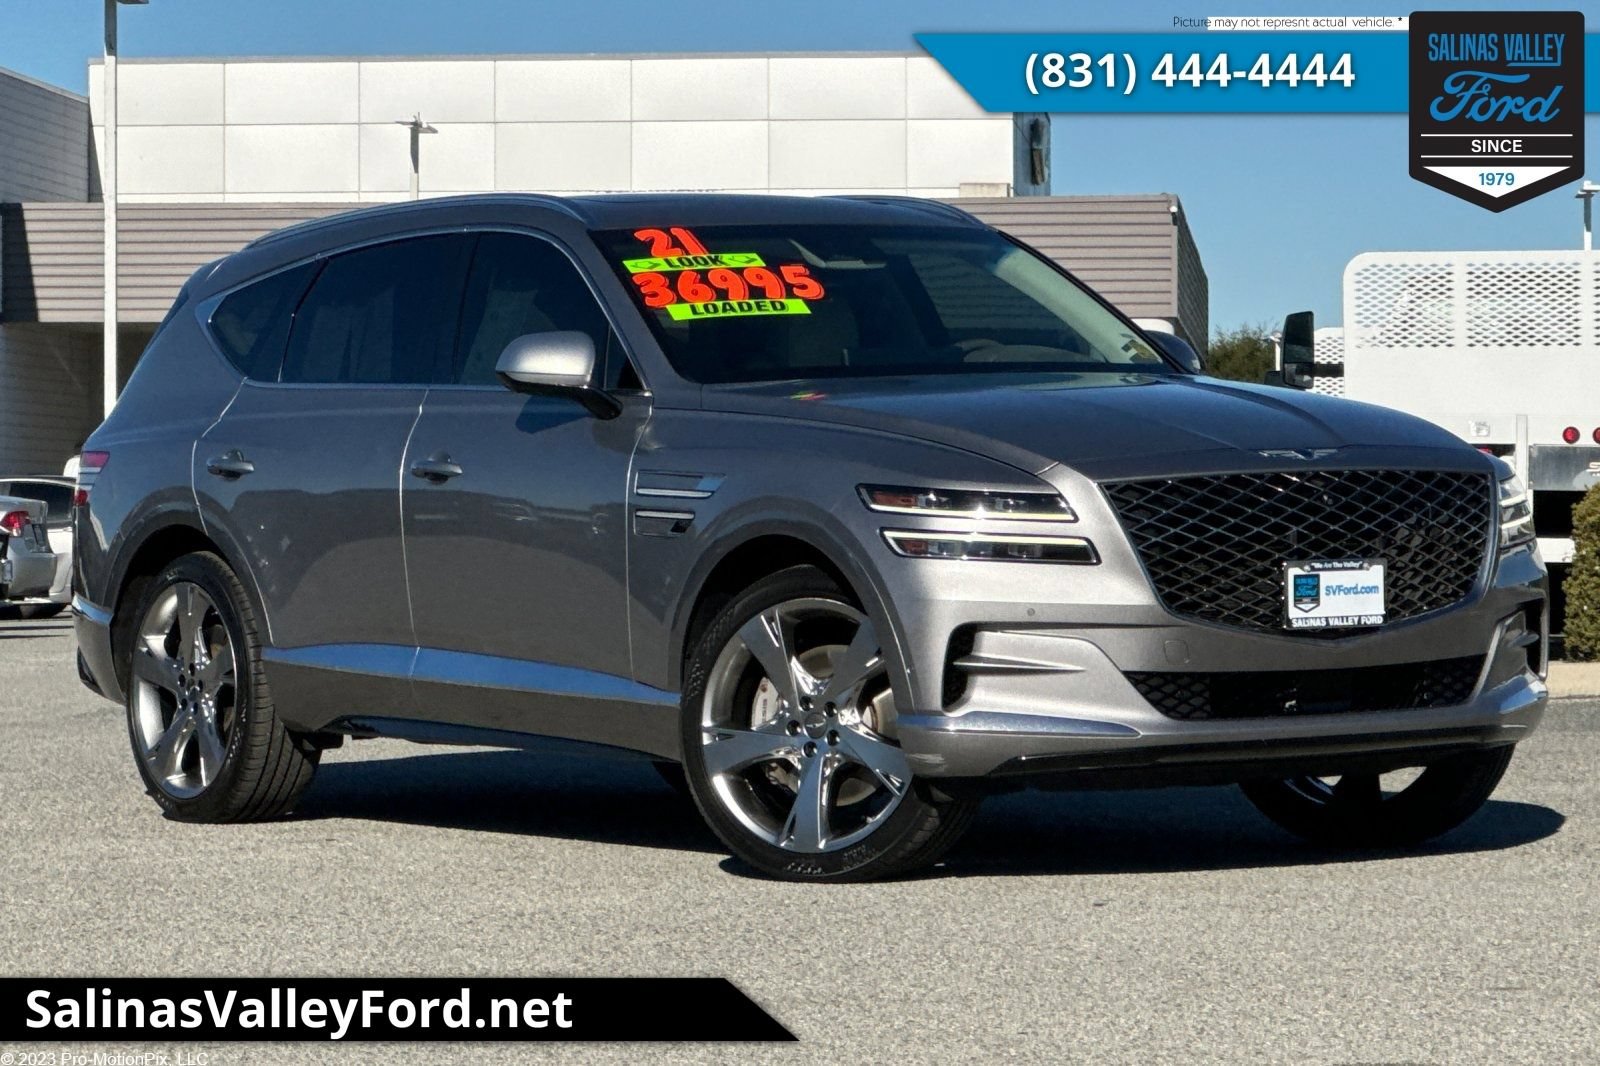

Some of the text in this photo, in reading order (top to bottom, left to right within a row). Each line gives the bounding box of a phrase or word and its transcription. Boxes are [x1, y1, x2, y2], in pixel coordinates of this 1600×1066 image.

[633, 227, 709, 257] 21
[663, 255, 723, 268] LOOK
[631, 265, 825, 308] 36995
[690, 300, 788, 316] LOADED
[1325, 584, 1379, 596] SVFord.com
[1292, 615, 1383, 628] SALINAS VALLEY FORD
